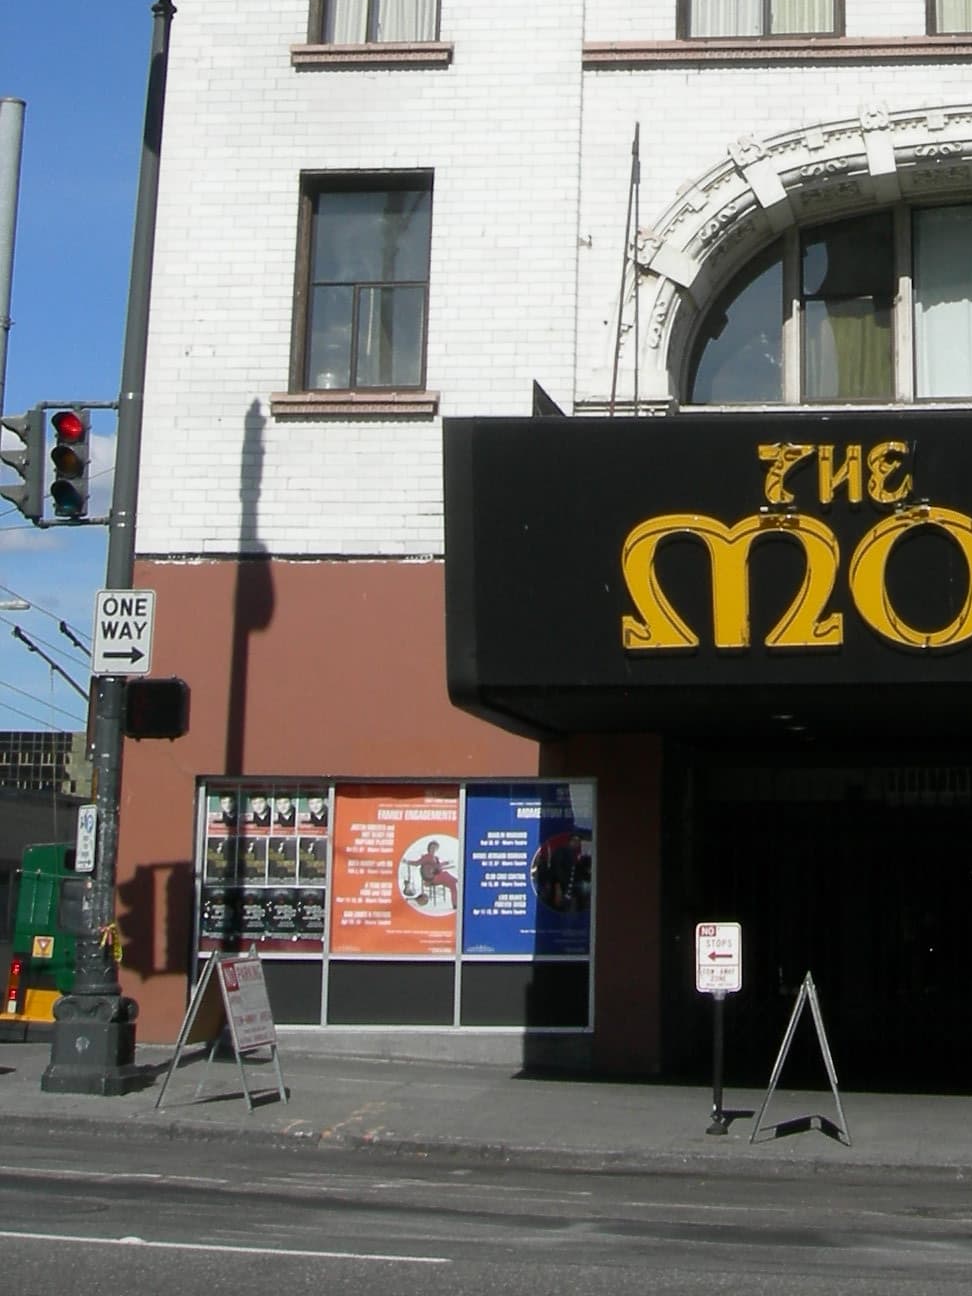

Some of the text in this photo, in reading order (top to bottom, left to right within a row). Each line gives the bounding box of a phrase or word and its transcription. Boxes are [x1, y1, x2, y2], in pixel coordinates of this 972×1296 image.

[758, 440, 914, 504] THE
[102, 597, 148, 617] ONE
[101, 620, 148, 640] WAY
[701, 926, 715, 936] NO
